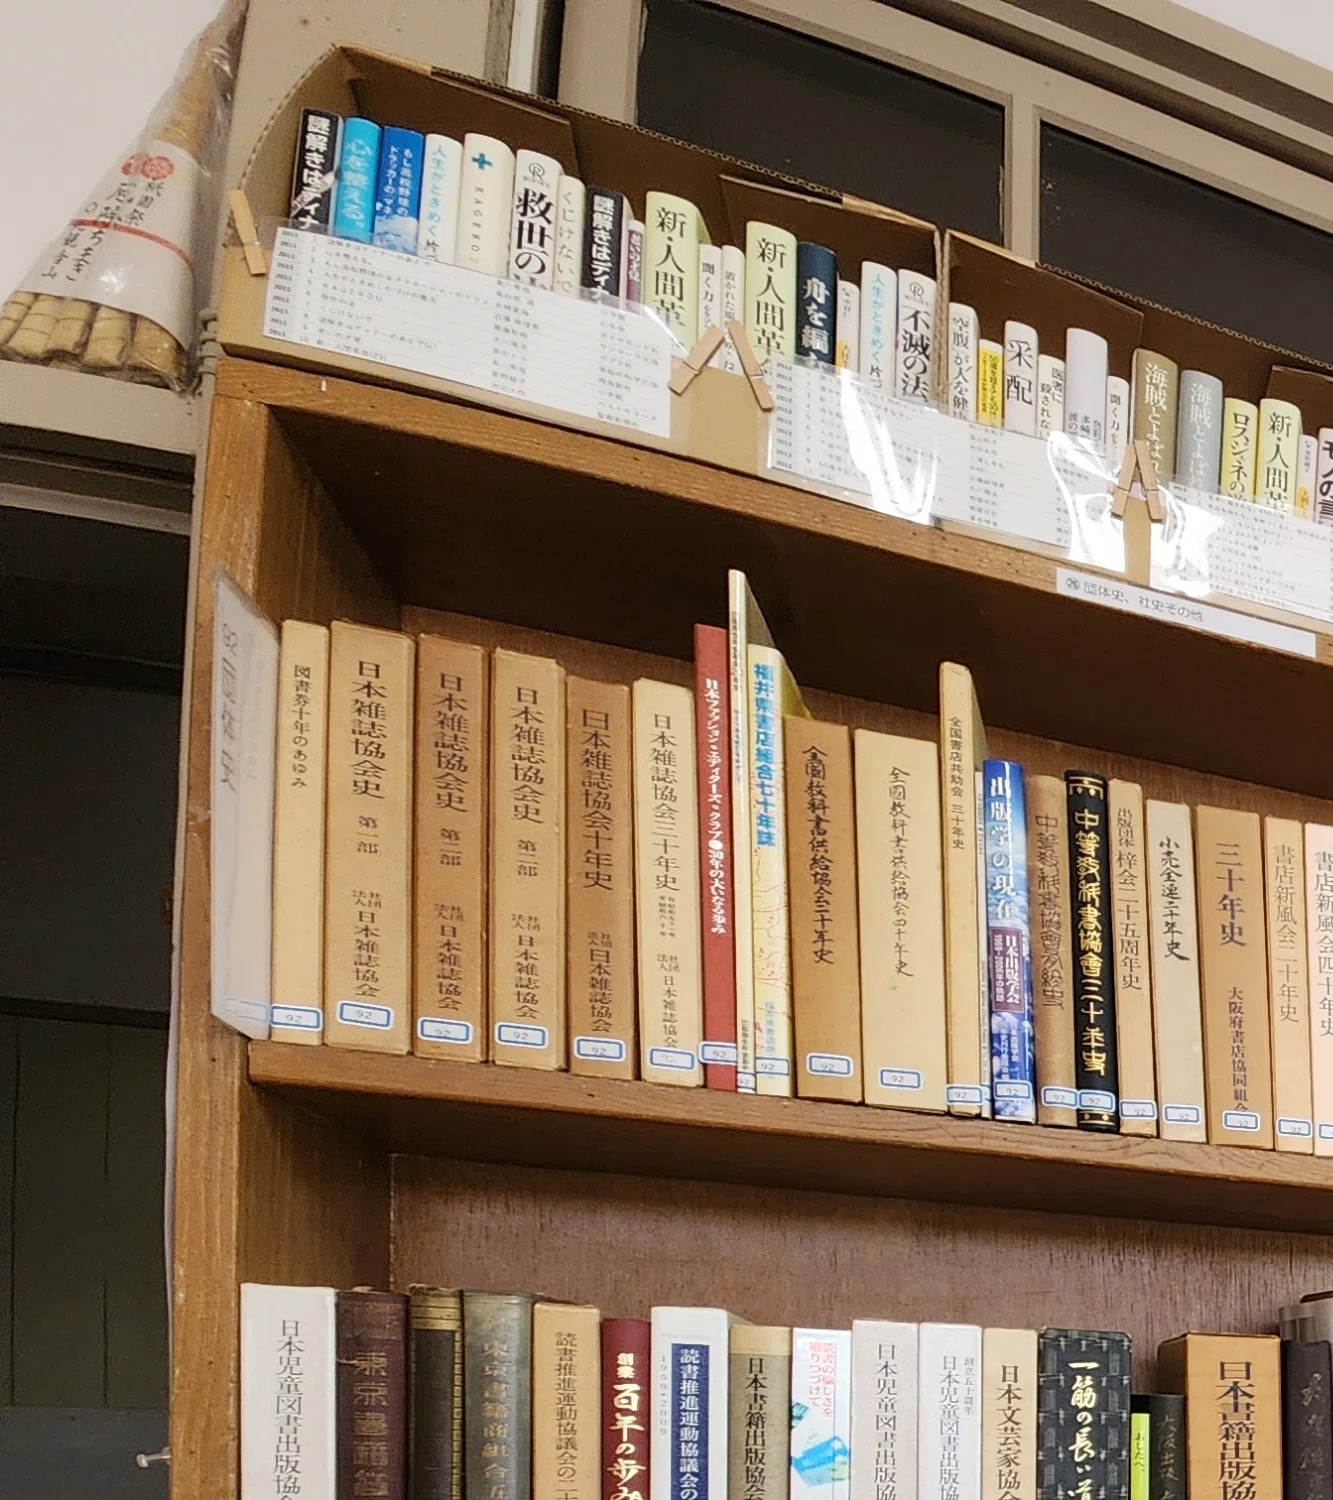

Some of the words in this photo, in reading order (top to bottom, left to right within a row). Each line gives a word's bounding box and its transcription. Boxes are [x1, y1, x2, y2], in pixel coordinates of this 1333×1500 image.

[1006, 340, 1034, 406] 采配
[293, 663, 312, 790] 図書券十年のあゆみ
[350, 658, 389, 800] 日本雑誌協会史
[432, 672, 471, 814] 日本雑誌協会史
[509, 686, 547, 825] 日本雑誌協会史
[355, 814, 381, 855] 第一部
[438, 827, 463, 868] 第二部
[580, 707, 616, 892] 日本雑誌協会十年史
[647, 713, 681, 893] 日本雑誌協会三十年史
[988, 775, 1018, 921] 出版学の現在
[515, 839, 539, 880] 第二部
[1214, 842, 1248, 948] 三十年史
[353, 910, 382, 998] 日本雑誌協会
[435, 925, 463, 1013] 日本雑誌協会
[513, 934, 540, 1020] 日本雑誌協会
[1273, 843, 1300, 1025] 書店新風会二十年史
[587, 949, 614, 1035] 日本雑誌協会
[660, 975, 680, 1049] 日本雑誌協会
